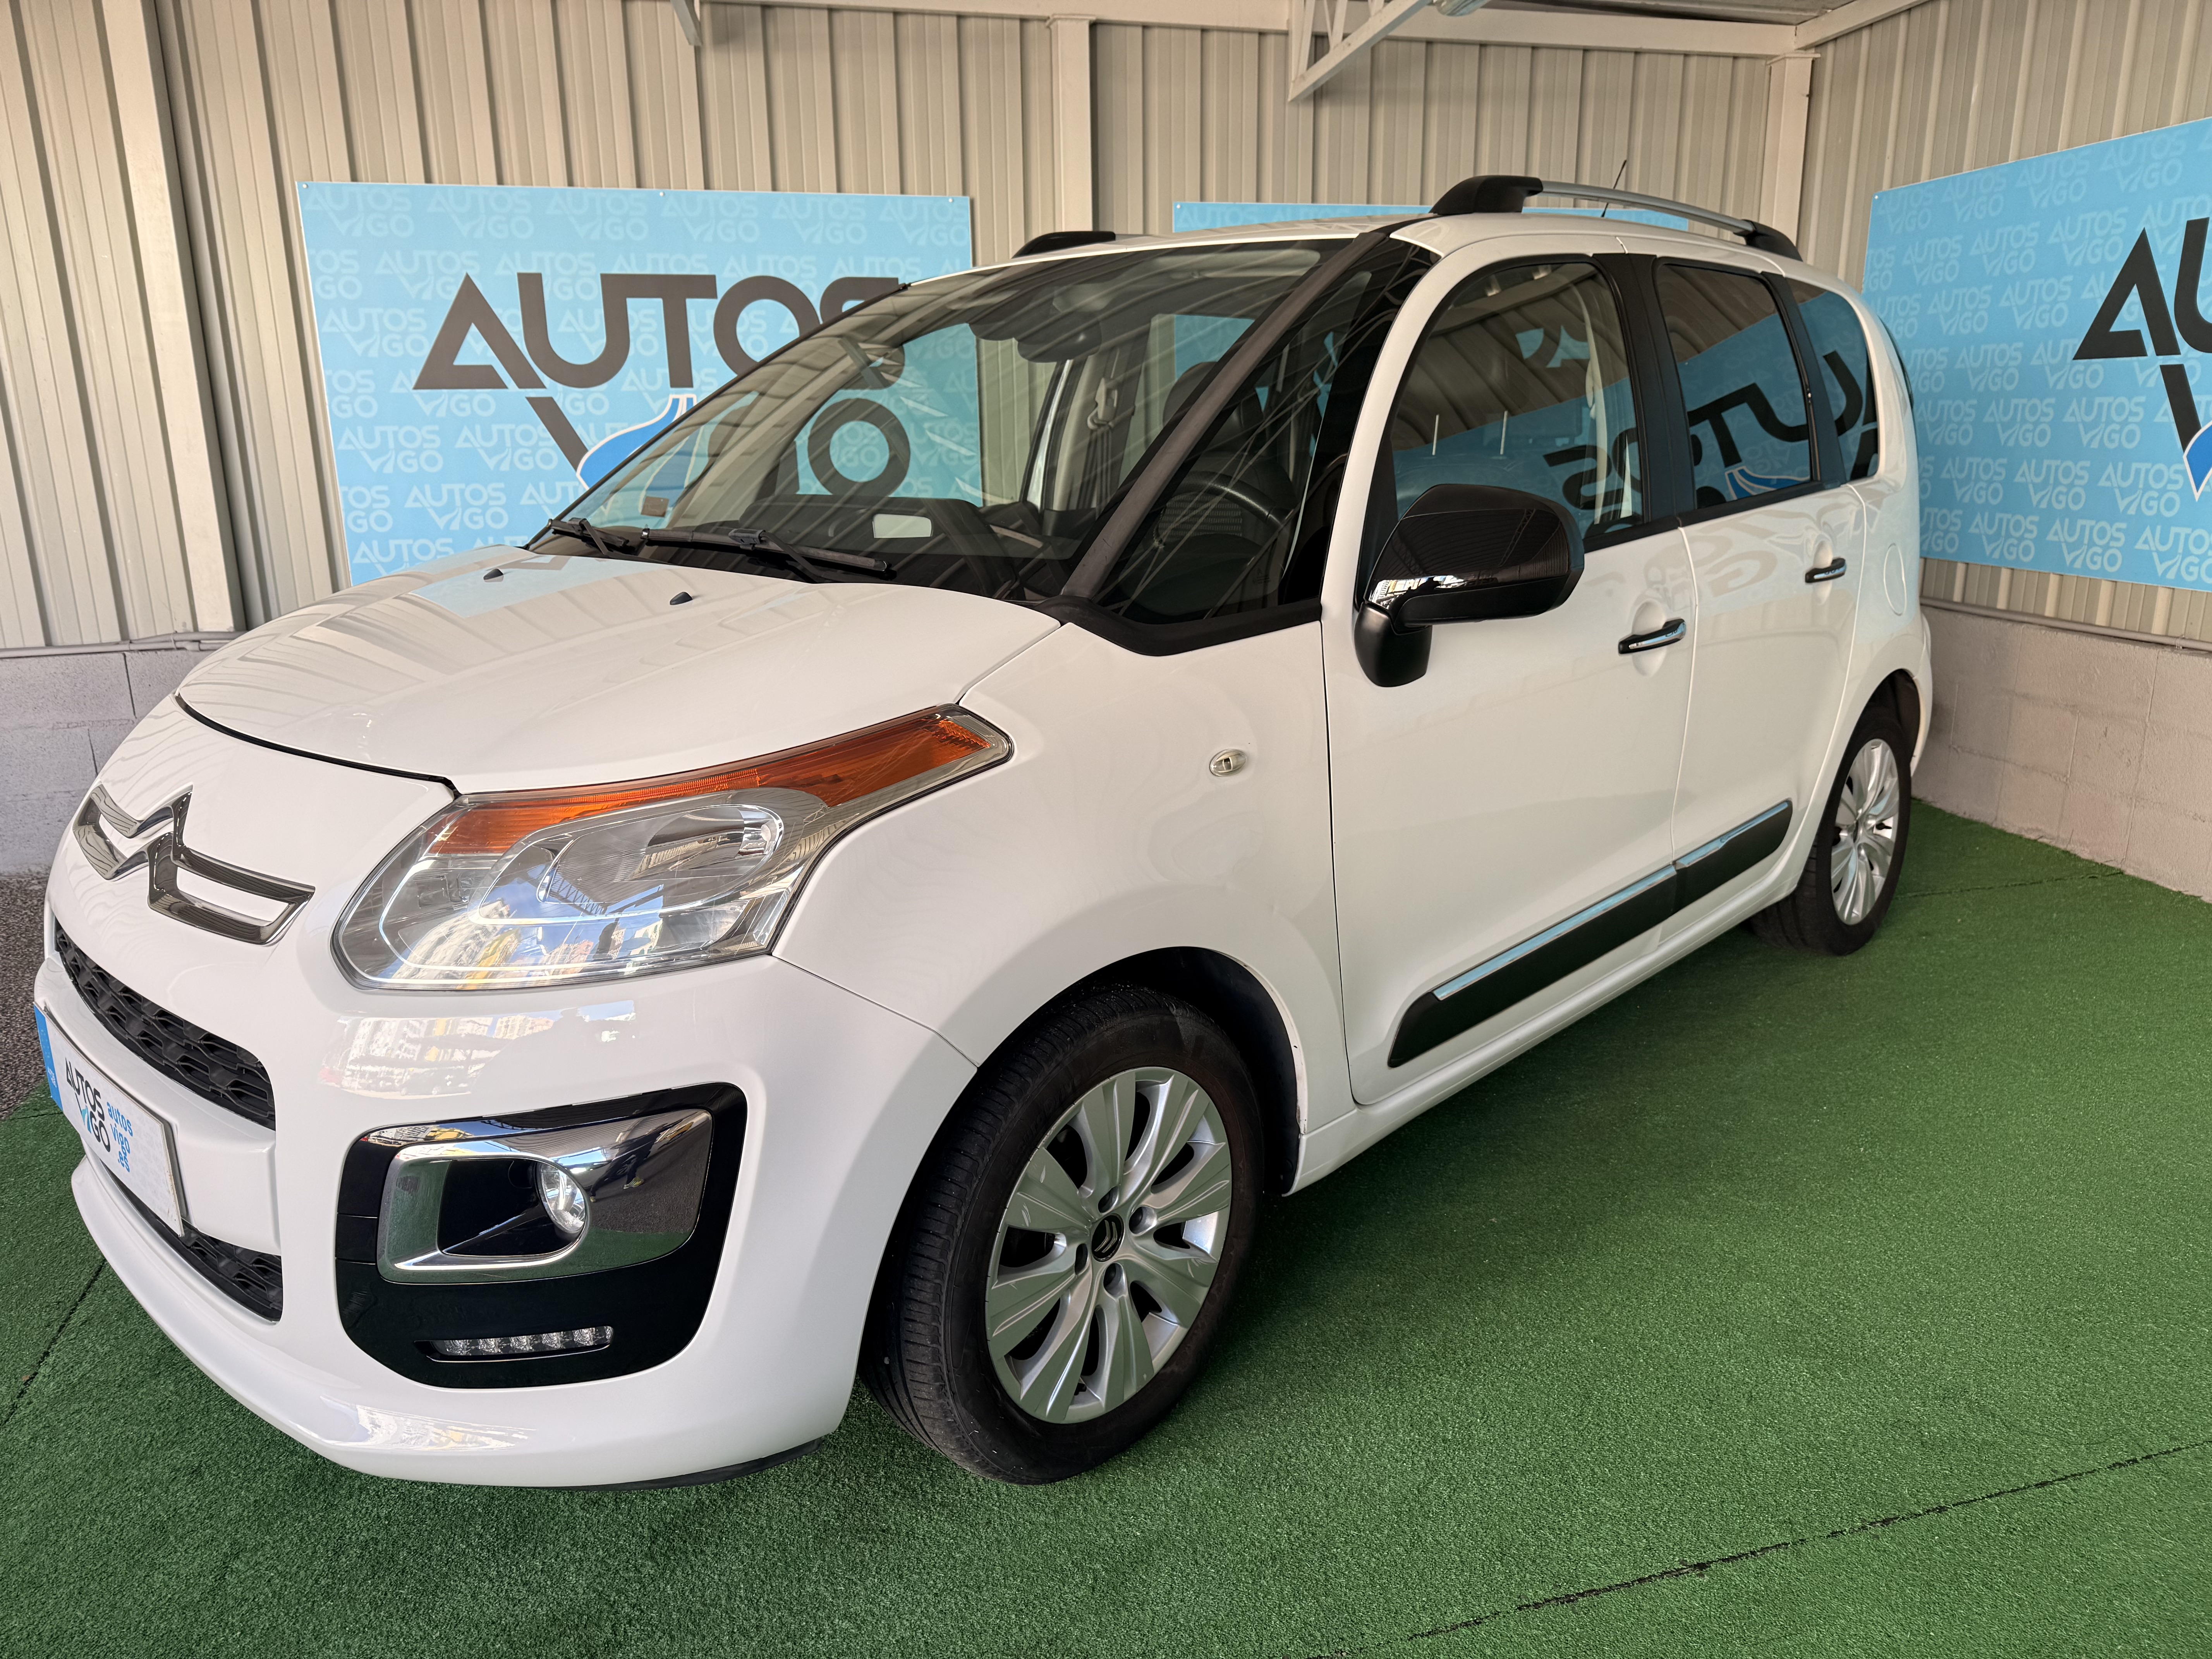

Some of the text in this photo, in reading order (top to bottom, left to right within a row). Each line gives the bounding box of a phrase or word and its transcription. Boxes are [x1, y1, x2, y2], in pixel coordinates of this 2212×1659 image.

[2100, 129, 2188, 170] AUTOS
[2017, 151, 2089, 186] AUTOS
[2118, 159, 2181, 192] VIGO
[1942, 168, 2006, 202] AUTOS
[2031, 179, 2085, 208] VIGO
[306, 187, 410, 211] AUTOS
[428, 189, 530, 213] AUTOS
[547, 191, 646, 215] AUTOS
[662, 194, 757, 218] AUTOS
[773, 196, 865, 220] AUTOS
[880, 199, 967, 222] AUTOS
[1879, 185, 1932, 214] AUTOS
[1955, 195, 2002, 221] VIGO
[330, 213, 413, 237] VIGO
[2048, 207, 2128, 243] AUTOS
[2137, 194, 2212, 231] AUTO
[451, 215, 532, 238] VIGO
[570, 217, 647, 240] VIGO
[684, 219, 759, 242] VIGO
[793, 221, 866, 244] VIGO
[1971, 222, 2039, 255] AUTOS
[376, 250, 479, 274] AUTOS
[1903, 236, 1962, 265] AUTOS
[1984, 249, 2034, 276] VIGO
[2064, 237, 2122, 265] VIGO
[495, 252, 596, 275] AUTOS
[612, 254, 708, 273] AUTOS
[724, 255, 816, 277] AUTOS
[1915, 260, 1958, 285] VIGO
[1929, 285, 1992, 313] AUTOS
[1999, 276, 2073, 306] AUTOS
[1877, 294, 1920, 318] UTOS
[2014, 303, 2068, 329] VIGO
[323, 308, 426, 332] AUTOS
[1941, 311, 1987, 335] VIGO
[345, 333, 429, 357] VIGO
[1955, 343, 2022, 368] AUTOS
[2031, 338, 2078, 364] AUT
[1903, 348, 1948, 369] UTOS
[1968, 368, 2018, 392] VIGO
[2046, 364, 2103, 389] VIGO
[1917, 399, 1976, 422] AUTOS
[1984, 398, 2054, 422] AUTOS
[2063, 396, 2145, 421] AUTOS
[338, 425, 440, 449] AUTOS
[1927, 423, 1972, 445] VIGO
[1998, 423, 2050, 447] VIGO
[2079, 422, 2140, 448] VIGO
[361, 449, 443, 473] VIGO
[478, 448, 558, 471] VIGO
[1942, 457, 2006, 481] AUTOS
[2015, 459, 2089, 485] AUTOS
[2098, 462, 2184, 489] AUTOS
[405, 483, 505, 508] AUTOS
[1954, 480, 2002, 504] VIGO
[2029, 485, 2085, 510] VIGO
[2115, 488, 2180, 517] VIGO
[428, 508, 508, 530] VIGO
[1970, 512, 2039, 539] AUTOS
[2047, 518, 2126, 546] AUTOS
[2135, 525, 2212, 555] AUTO
[1984, 535, 2034, 562] VIGO
[2062, 542, 2121, 571] VIGO
[65, 1056, 105, 1121] AUTOS
[75, 1092, 110, 1152] VIGO
[107, 1102, 133, 1137] autos
[110, 1123, 130, 1157] vigo
[118, 1151, 130, 1173] .es
